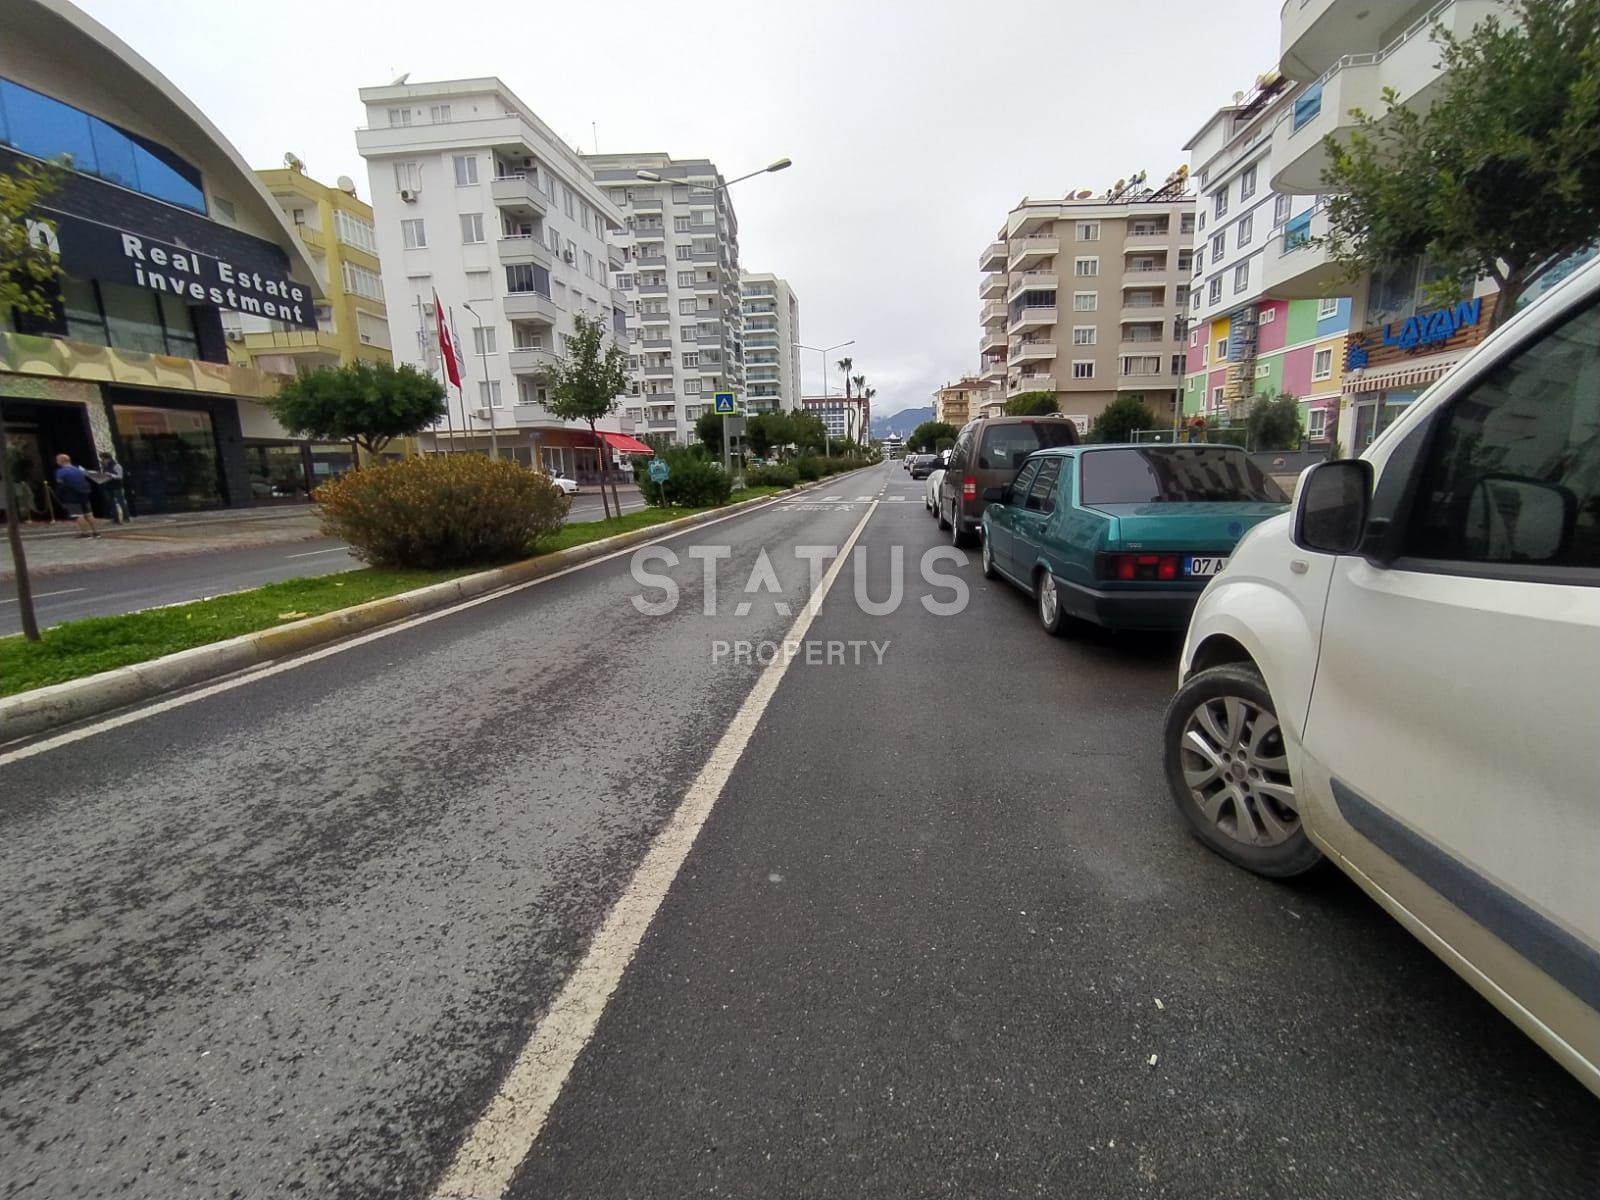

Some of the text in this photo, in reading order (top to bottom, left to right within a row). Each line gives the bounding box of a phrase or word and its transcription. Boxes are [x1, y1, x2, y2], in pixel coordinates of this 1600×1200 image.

[121, 233, 303, 302] Real Estate
[134, 263, 303, 323] investment
[1383, 297, 1482, 347] LAYAN
[1192, 559, 1211, 574] 07
